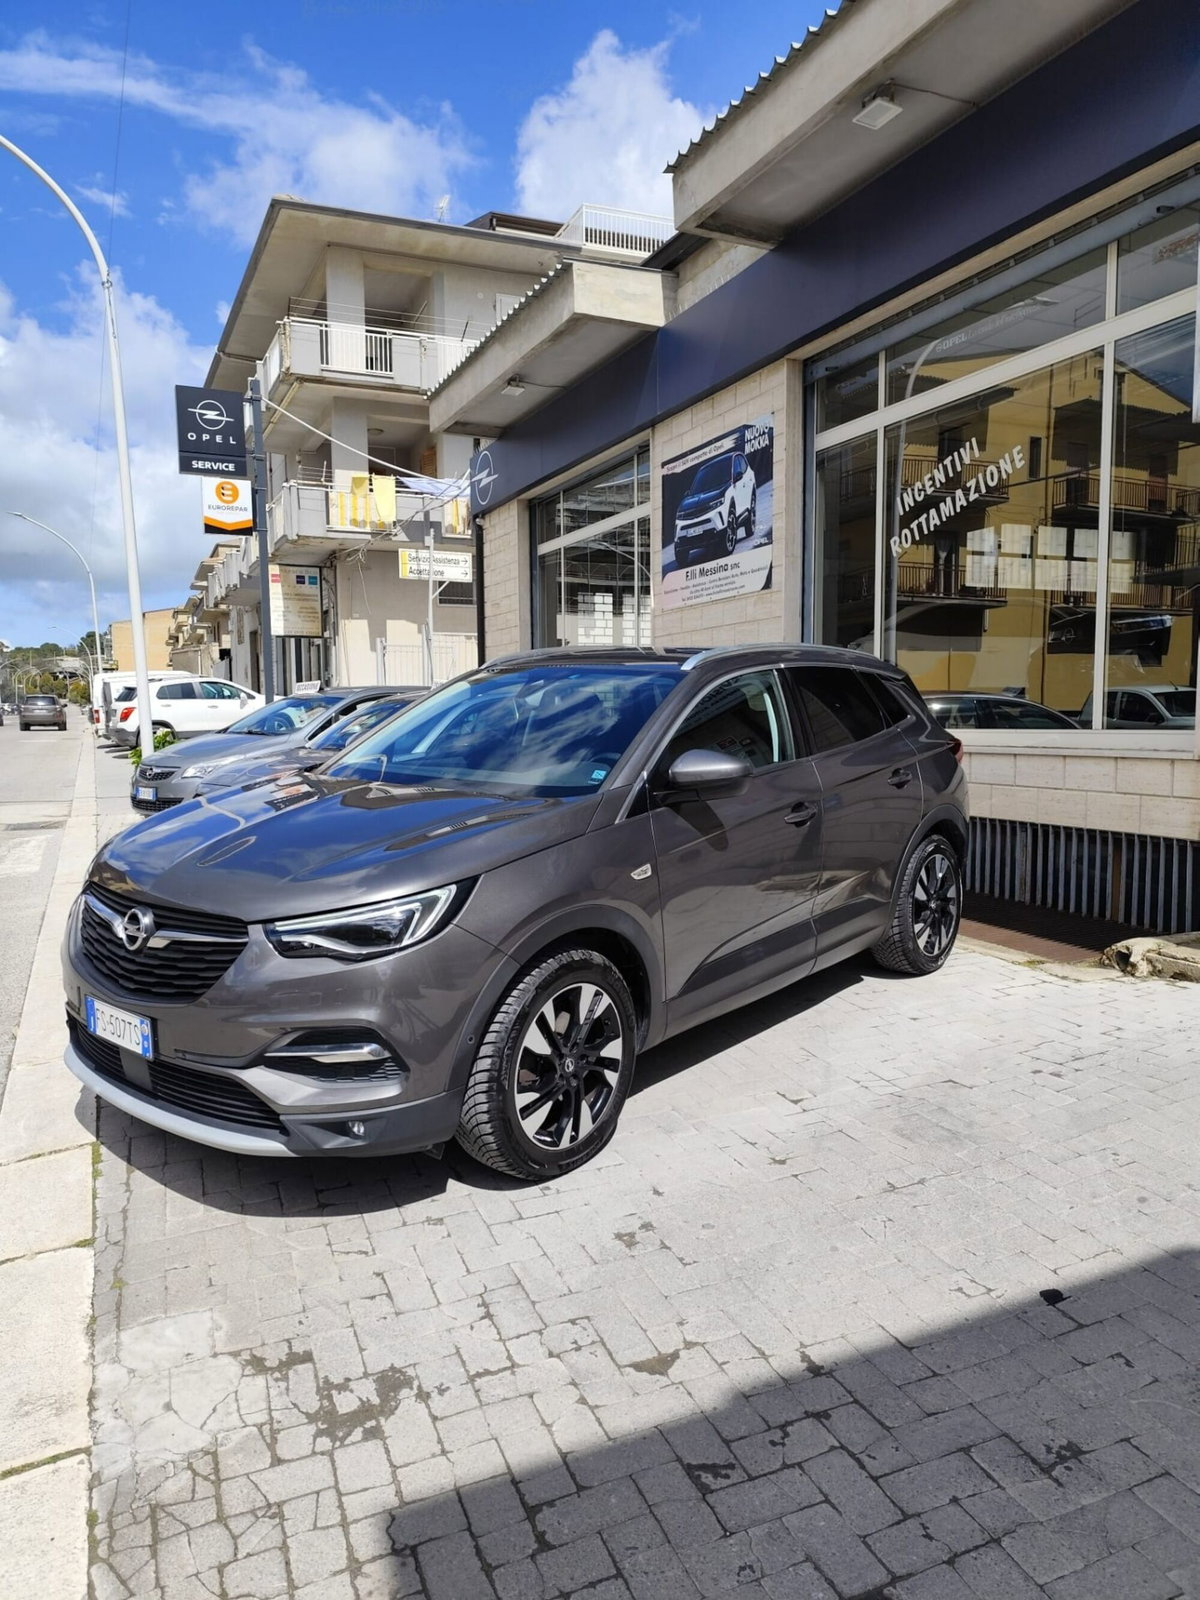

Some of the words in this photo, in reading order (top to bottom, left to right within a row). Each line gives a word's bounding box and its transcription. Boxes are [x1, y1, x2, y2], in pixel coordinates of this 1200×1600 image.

[187, 432, 236, 444] OPEL
[744, 423, 770, 442] NUOVO
[744, 434, 770, 455] MOKKA
[191, 460, 236, 471] SERVICE
[896, 437, 980, 516] INCENTIVI
[207, 503, 249, 513] EUROREPAR
[889, 445, 1026, 558] ROTTAMAZIONE
[685, 569, 697, 581] F.lli
[699, 562, 729, 579] Messina
[730, 561, 740, 570] snc
